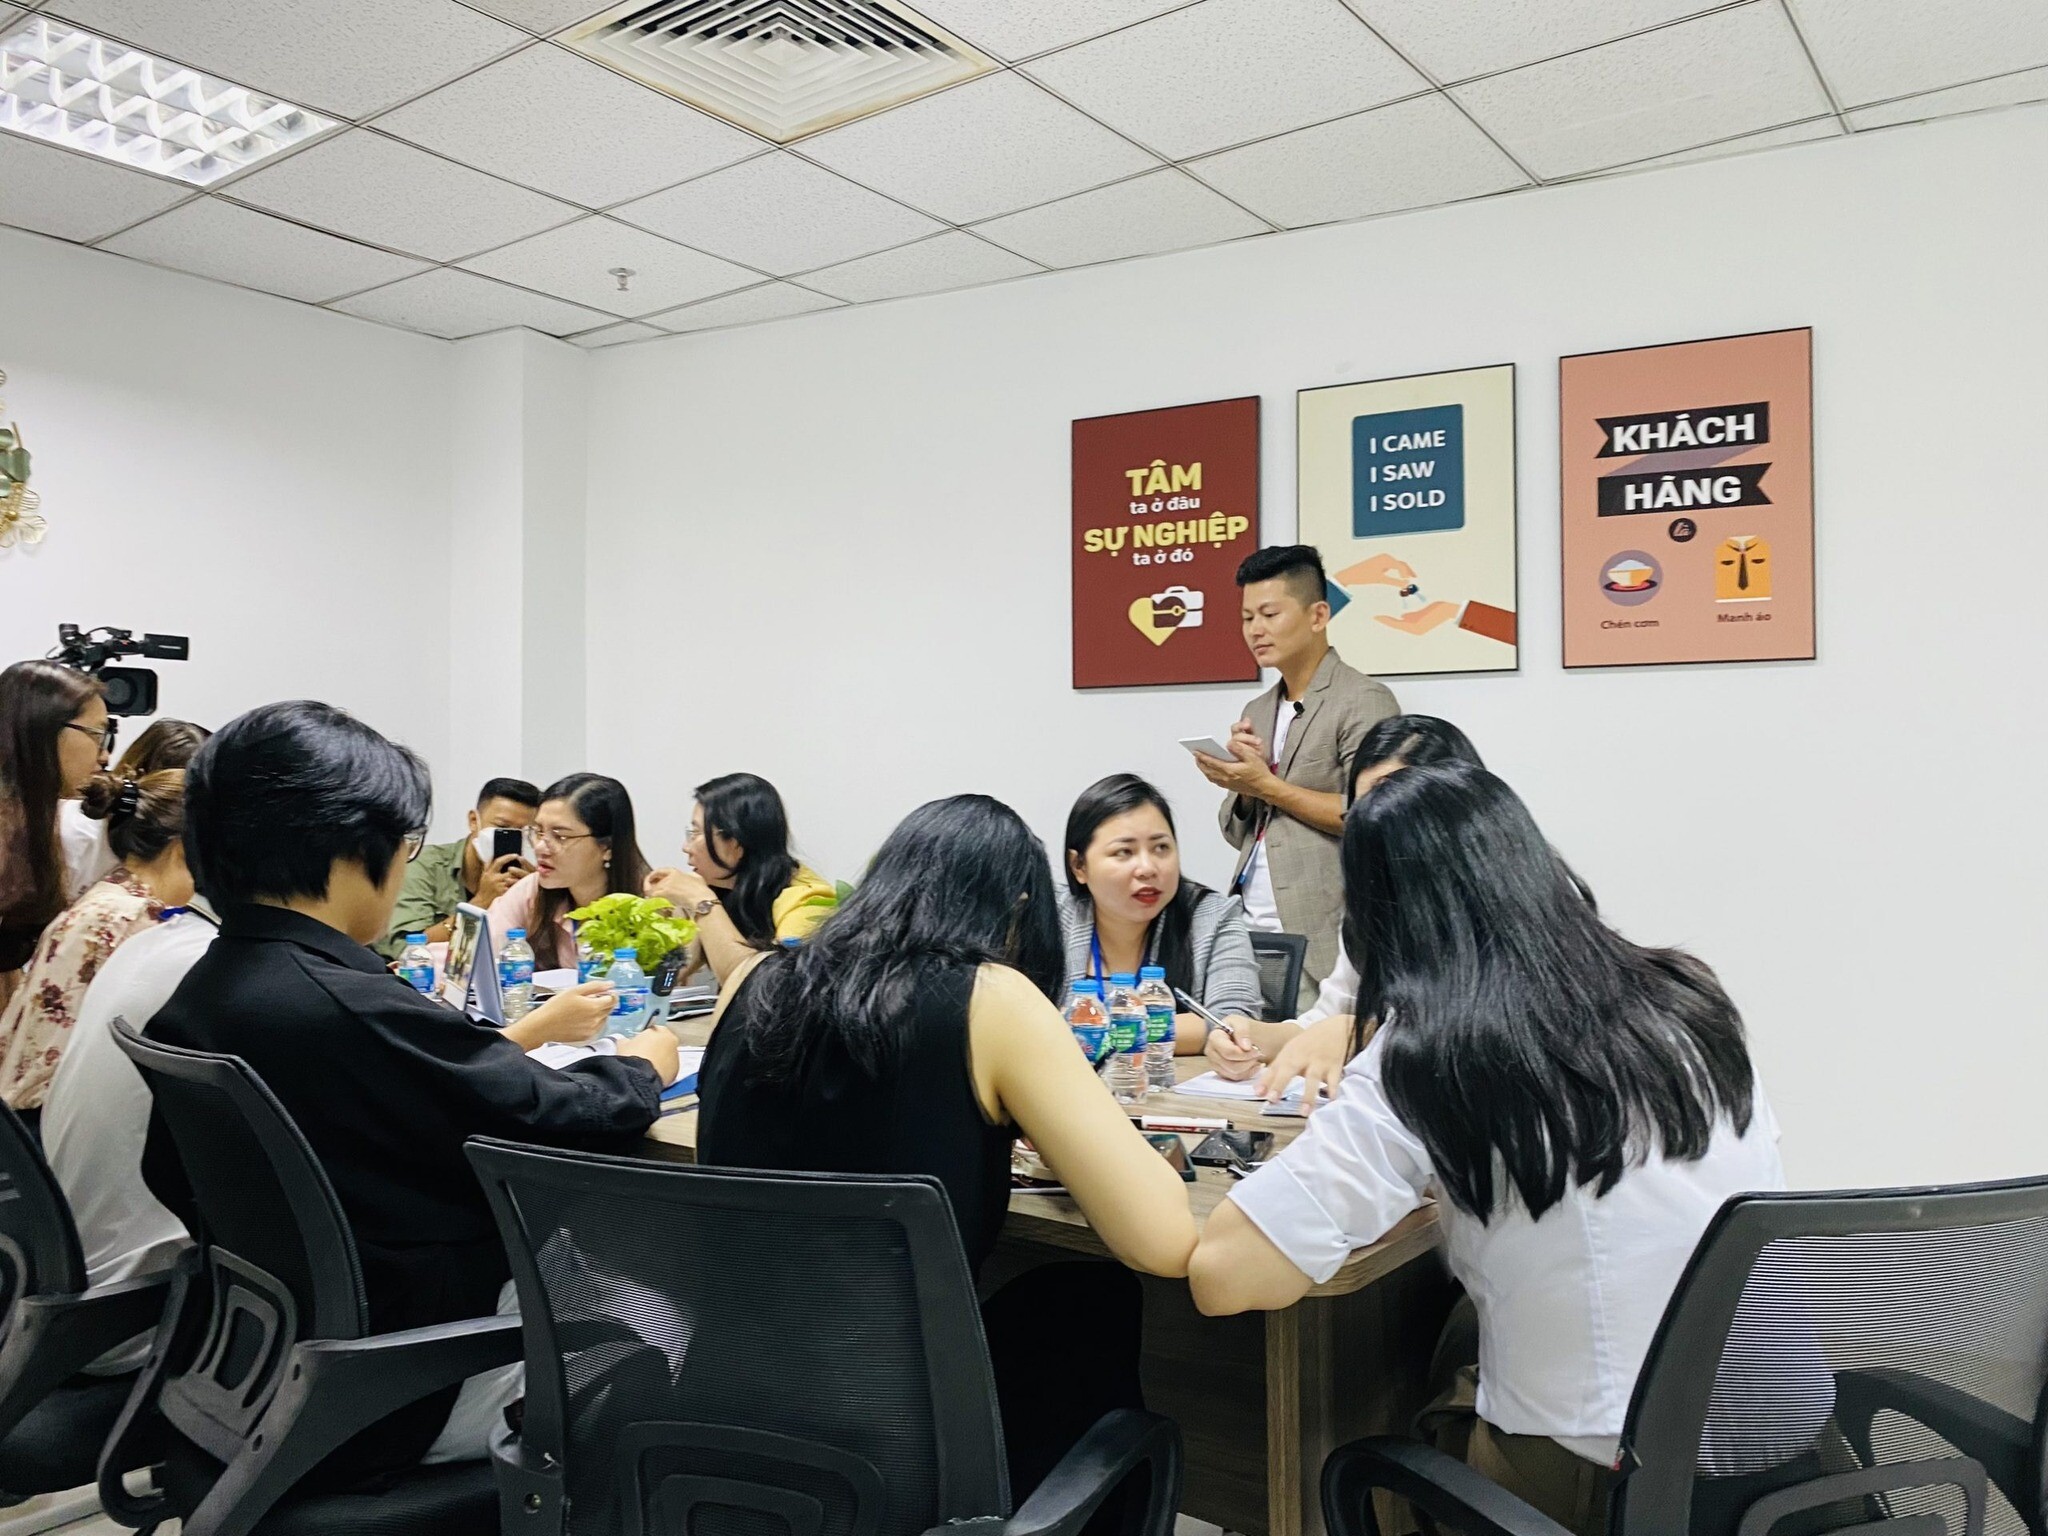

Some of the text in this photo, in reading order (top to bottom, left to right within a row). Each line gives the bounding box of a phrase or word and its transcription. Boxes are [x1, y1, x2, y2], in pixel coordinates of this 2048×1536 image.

[1370, 430, 1446, 454] I CAME
[1613, 413, 1756, 453] KHÁCH
[1125, 459, 1202, 496] TÂM
[1370, 460, 1436, 483] I SAW
[1129, 501, 1148, 515] ta
[1166, 497, 1201, 511] đâu
[1370, 489, 1446, 512] I SOLD
[1083, 511, 1249, 557] SỰ NGHIỆP
[1132, 552, 1151, 566] ta
[1169, 548, 1195, 563] đó
